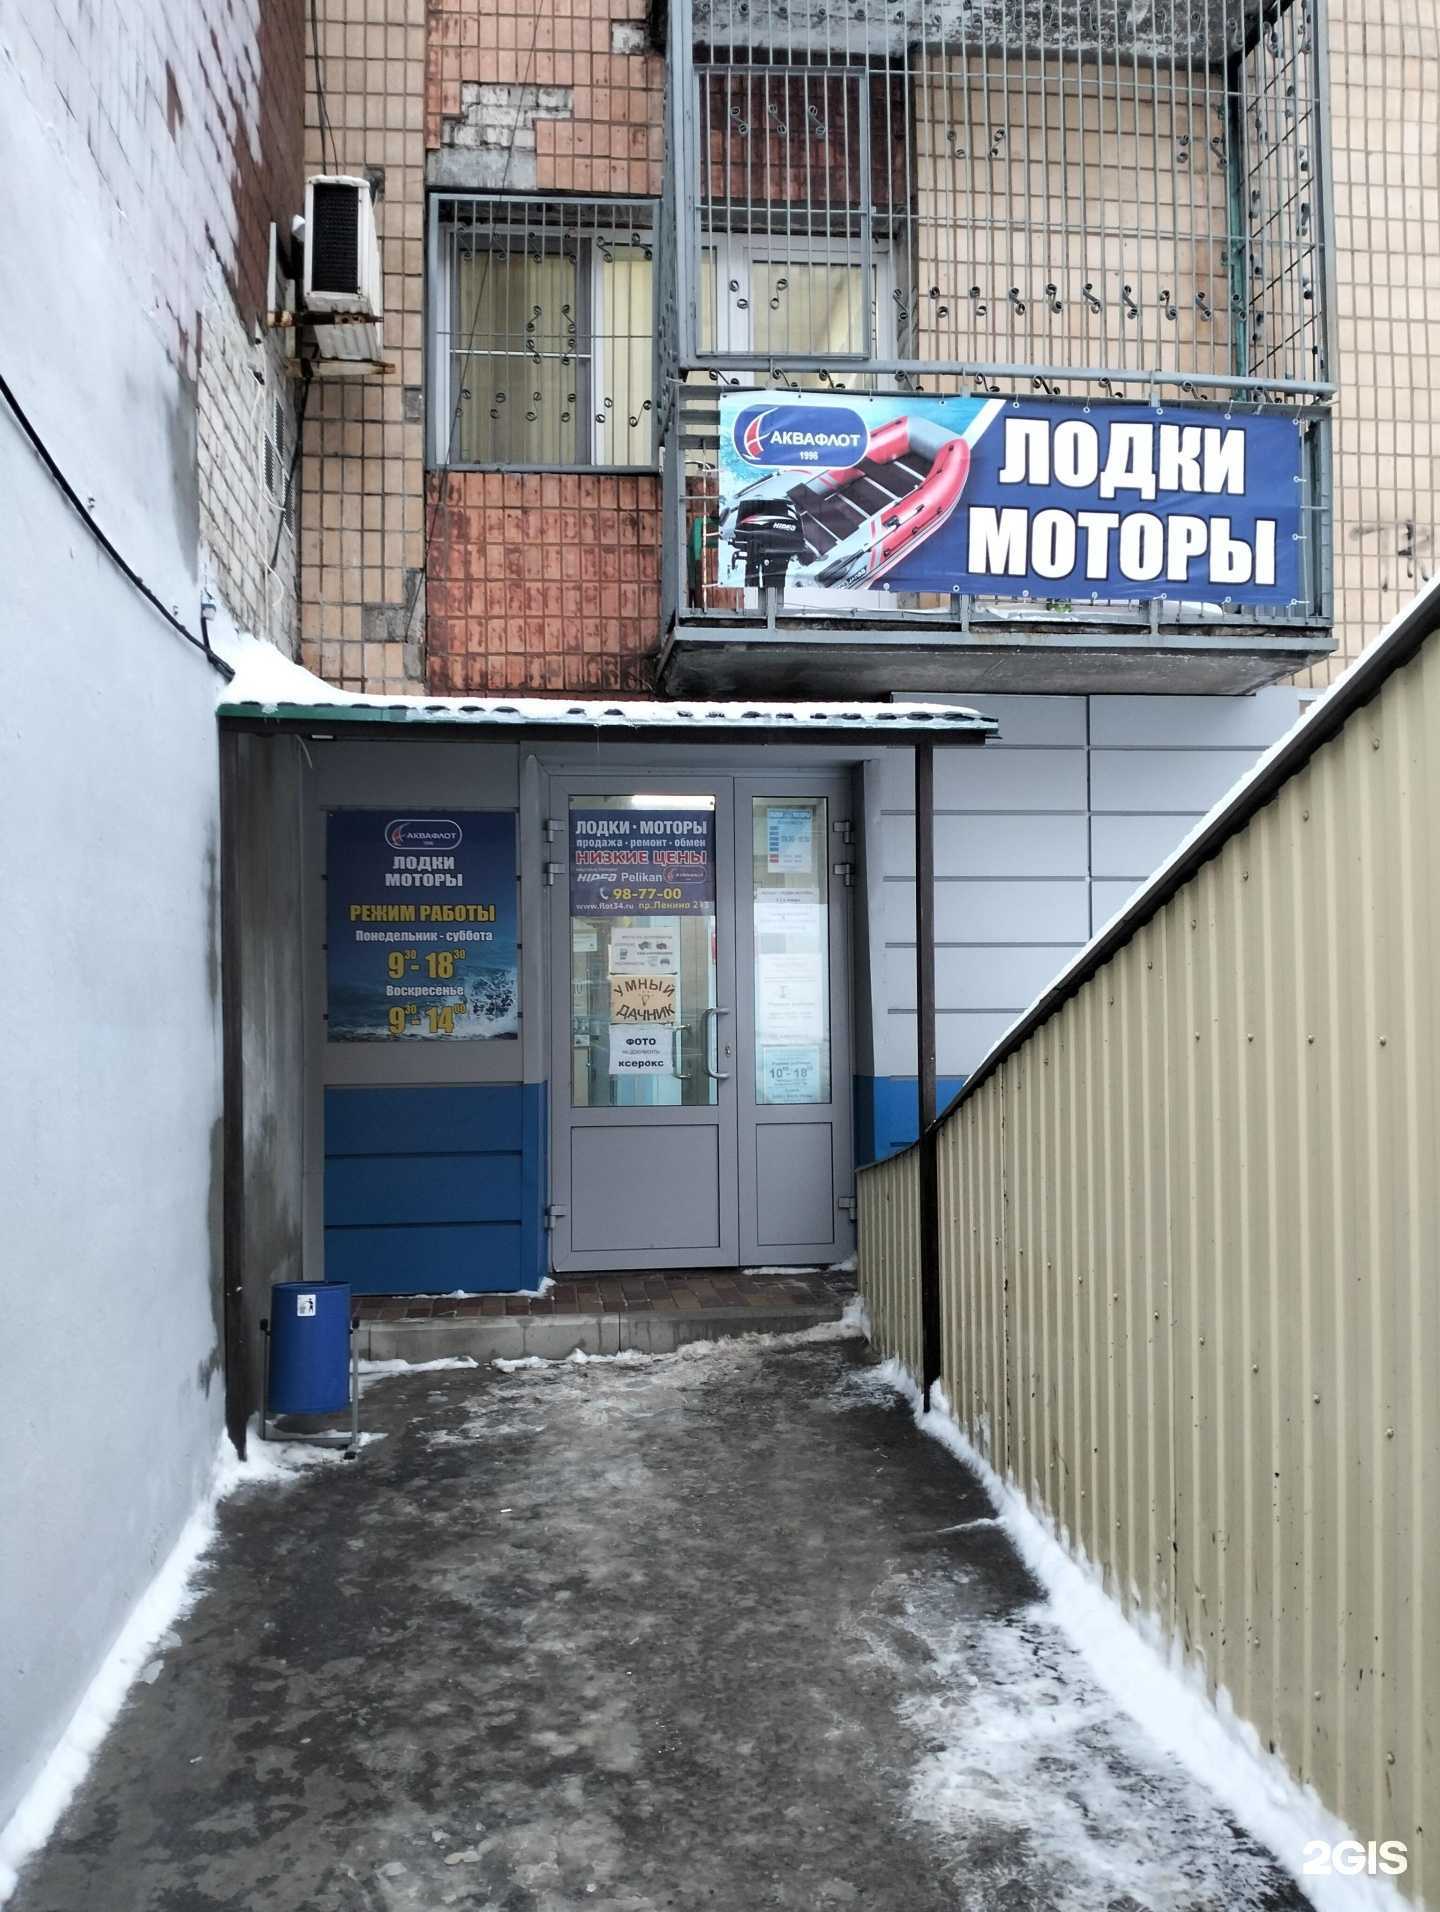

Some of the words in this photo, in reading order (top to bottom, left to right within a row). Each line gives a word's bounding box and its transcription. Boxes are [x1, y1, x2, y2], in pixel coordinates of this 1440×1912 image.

[770, 430, 860, 447] АКВАФЛОТ
[999, 416, 1246, 500] ЛОДКИ
[967, 506, 1276, 585] МОТОРЫ
[576, 820, 630, 836] ЛОДКИ
[640, 820, 707, 834] МОТОРЫ
[576, 838, 623, 848] продажа
[630, 838, 667, 848] ремонт
[674, 837, 706, 847] обмен
[392, 856, 455, 871] ЛОДКИ
[576, 850, 649, 865] НИЗКИЕ
[653, 850, 707, 867] ЦЕНЫ
[385, 873, 463, 887] МОТОРЫ
[621, 872, 663, 882] Pelikan
[613, 888, 682, 899] 98-77-00
[350, 905, 416, 921] РЕЖИМ
[419, 905, 496, 921] РАБОТЫ
[576, 902, 634, 910] www.flot34.ru
[356, 930, 438, 942] Понедельник
[446, 930, 493, 942] суббота
[386, 985, 464, 997] Воскресенье
[613, 978, 676, 998] УМНЫЙ
[616, 1004, 675, 1021] ДАЧНИК
[625, 1038, 656, 1046] ФОТО
[618, 1060, 664, 1068] ксерокс
